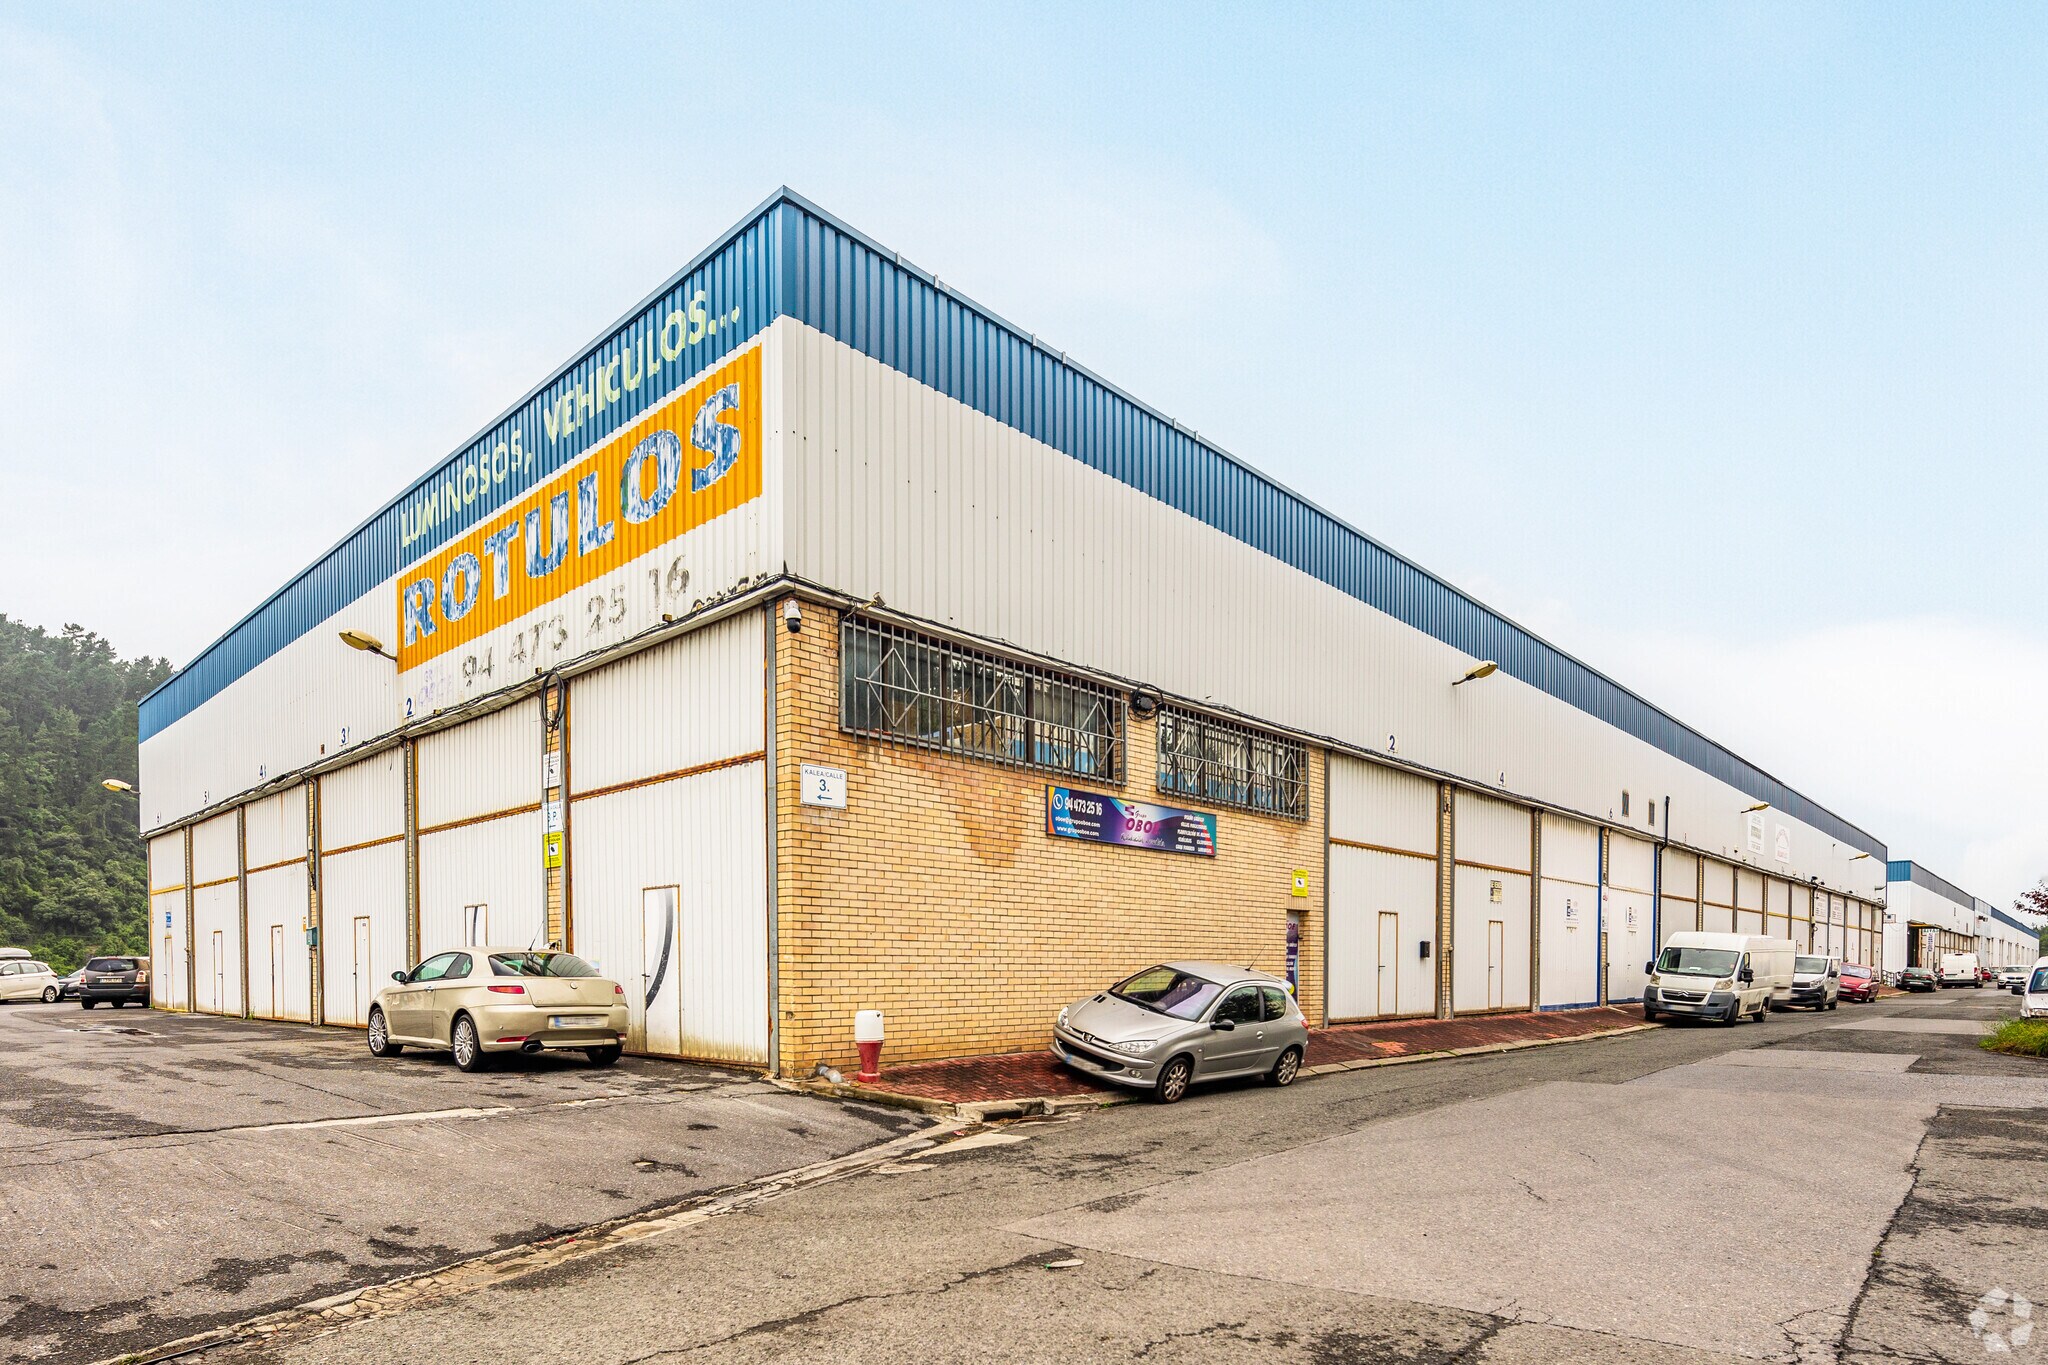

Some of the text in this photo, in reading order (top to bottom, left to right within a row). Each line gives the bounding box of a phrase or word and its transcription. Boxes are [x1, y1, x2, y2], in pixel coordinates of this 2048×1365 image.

[402, 429, 532, 548] LUMINOSOS,
[403, 381, 743, 649] ROTULOS
[462, 646, 493, 687] 94
[508, 613, 568, 664] 473
[585, 583, 627, 639] 25
[648, 553, 691, 609] 16
[406, 697, 413, 716] 2
[341, 727, 346, 744] 3
[1389, 734, 1396, 751] 2
[1499, 771, 1505, 785] 4
[1064, 796, 1074, 811] 94
[1086, 800, 1096, 815] 25
[1095, 802, 1103, 816] 16
